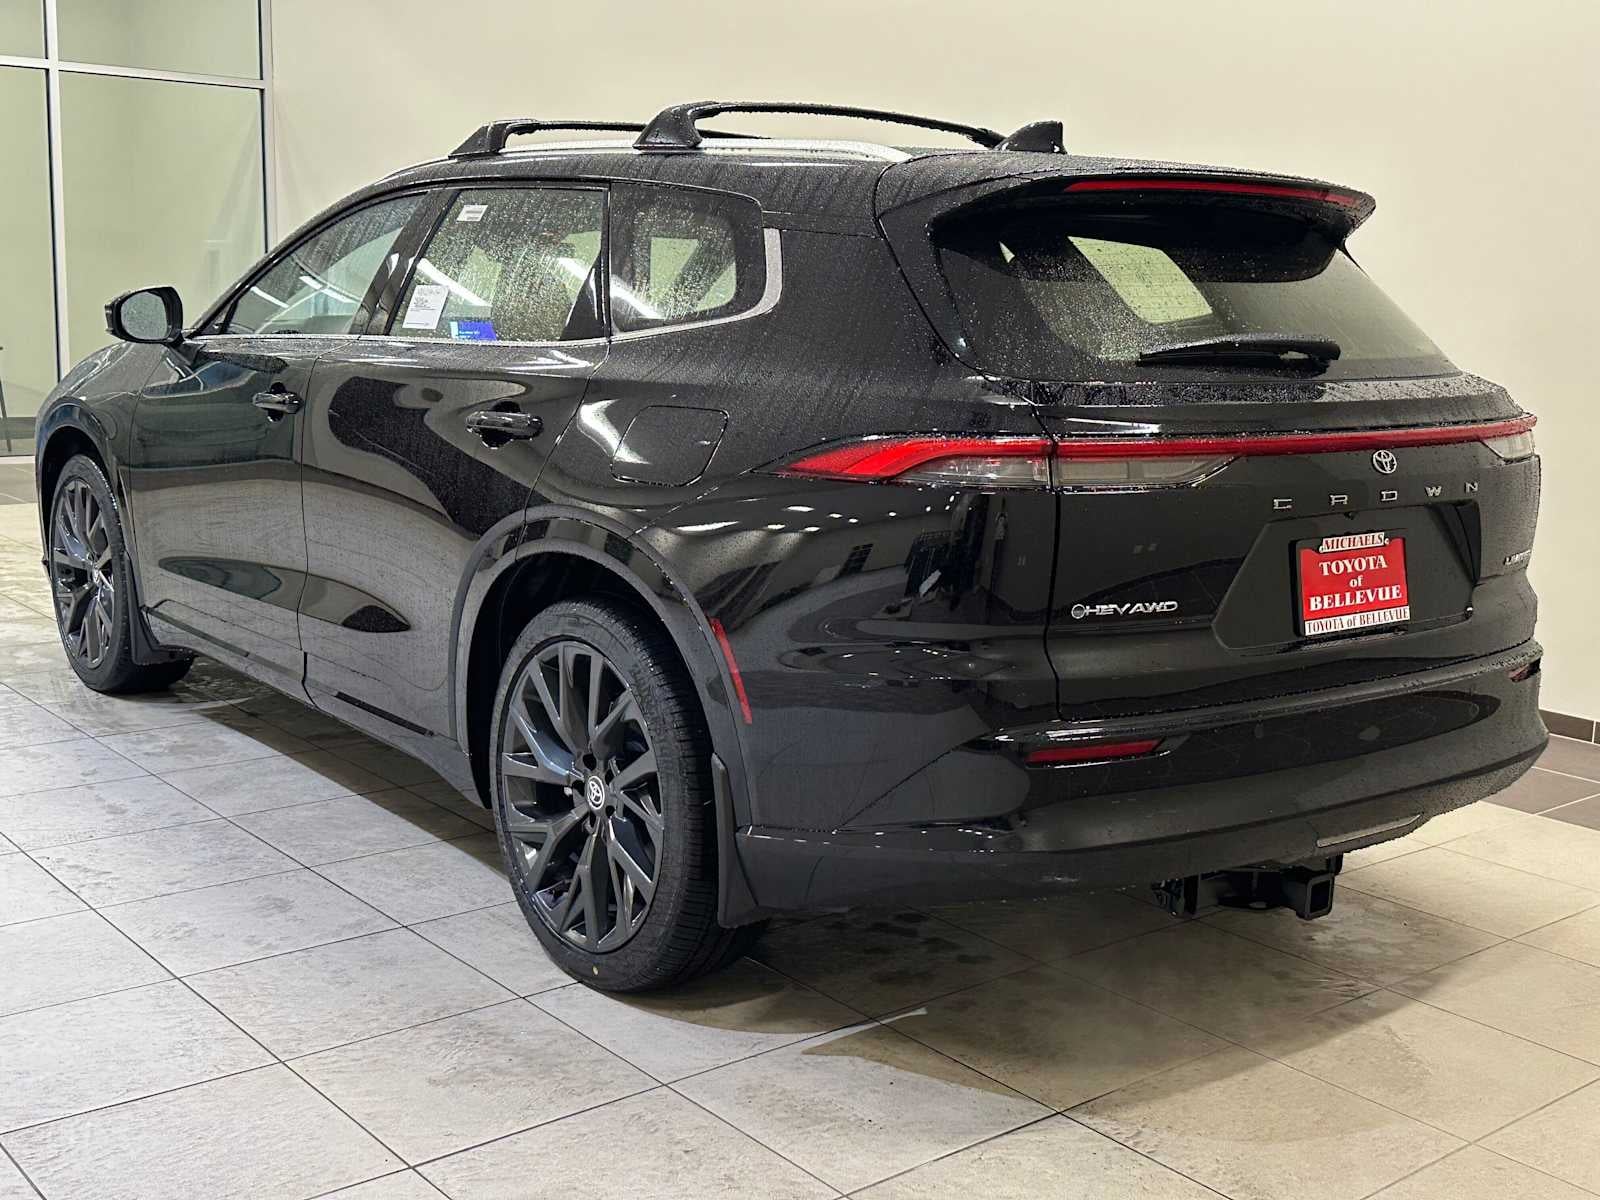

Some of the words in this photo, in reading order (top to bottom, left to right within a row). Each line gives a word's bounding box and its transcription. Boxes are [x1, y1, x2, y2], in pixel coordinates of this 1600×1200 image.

[1273, 481, 1479, 509] CROWN
[1323, 534, 1384, 550] MICHAELS
[1319, 555, 1387, 576] TOYOTA
[1349, 575, 1363, 588] of
[1309, 585, 1402, 611] BELLEVUE
[1307, 619, 1344, 634] TOYOTA
[1346, 615, 1357, 629] of
[1359, 608, 1408, 623] BELLEVUE
